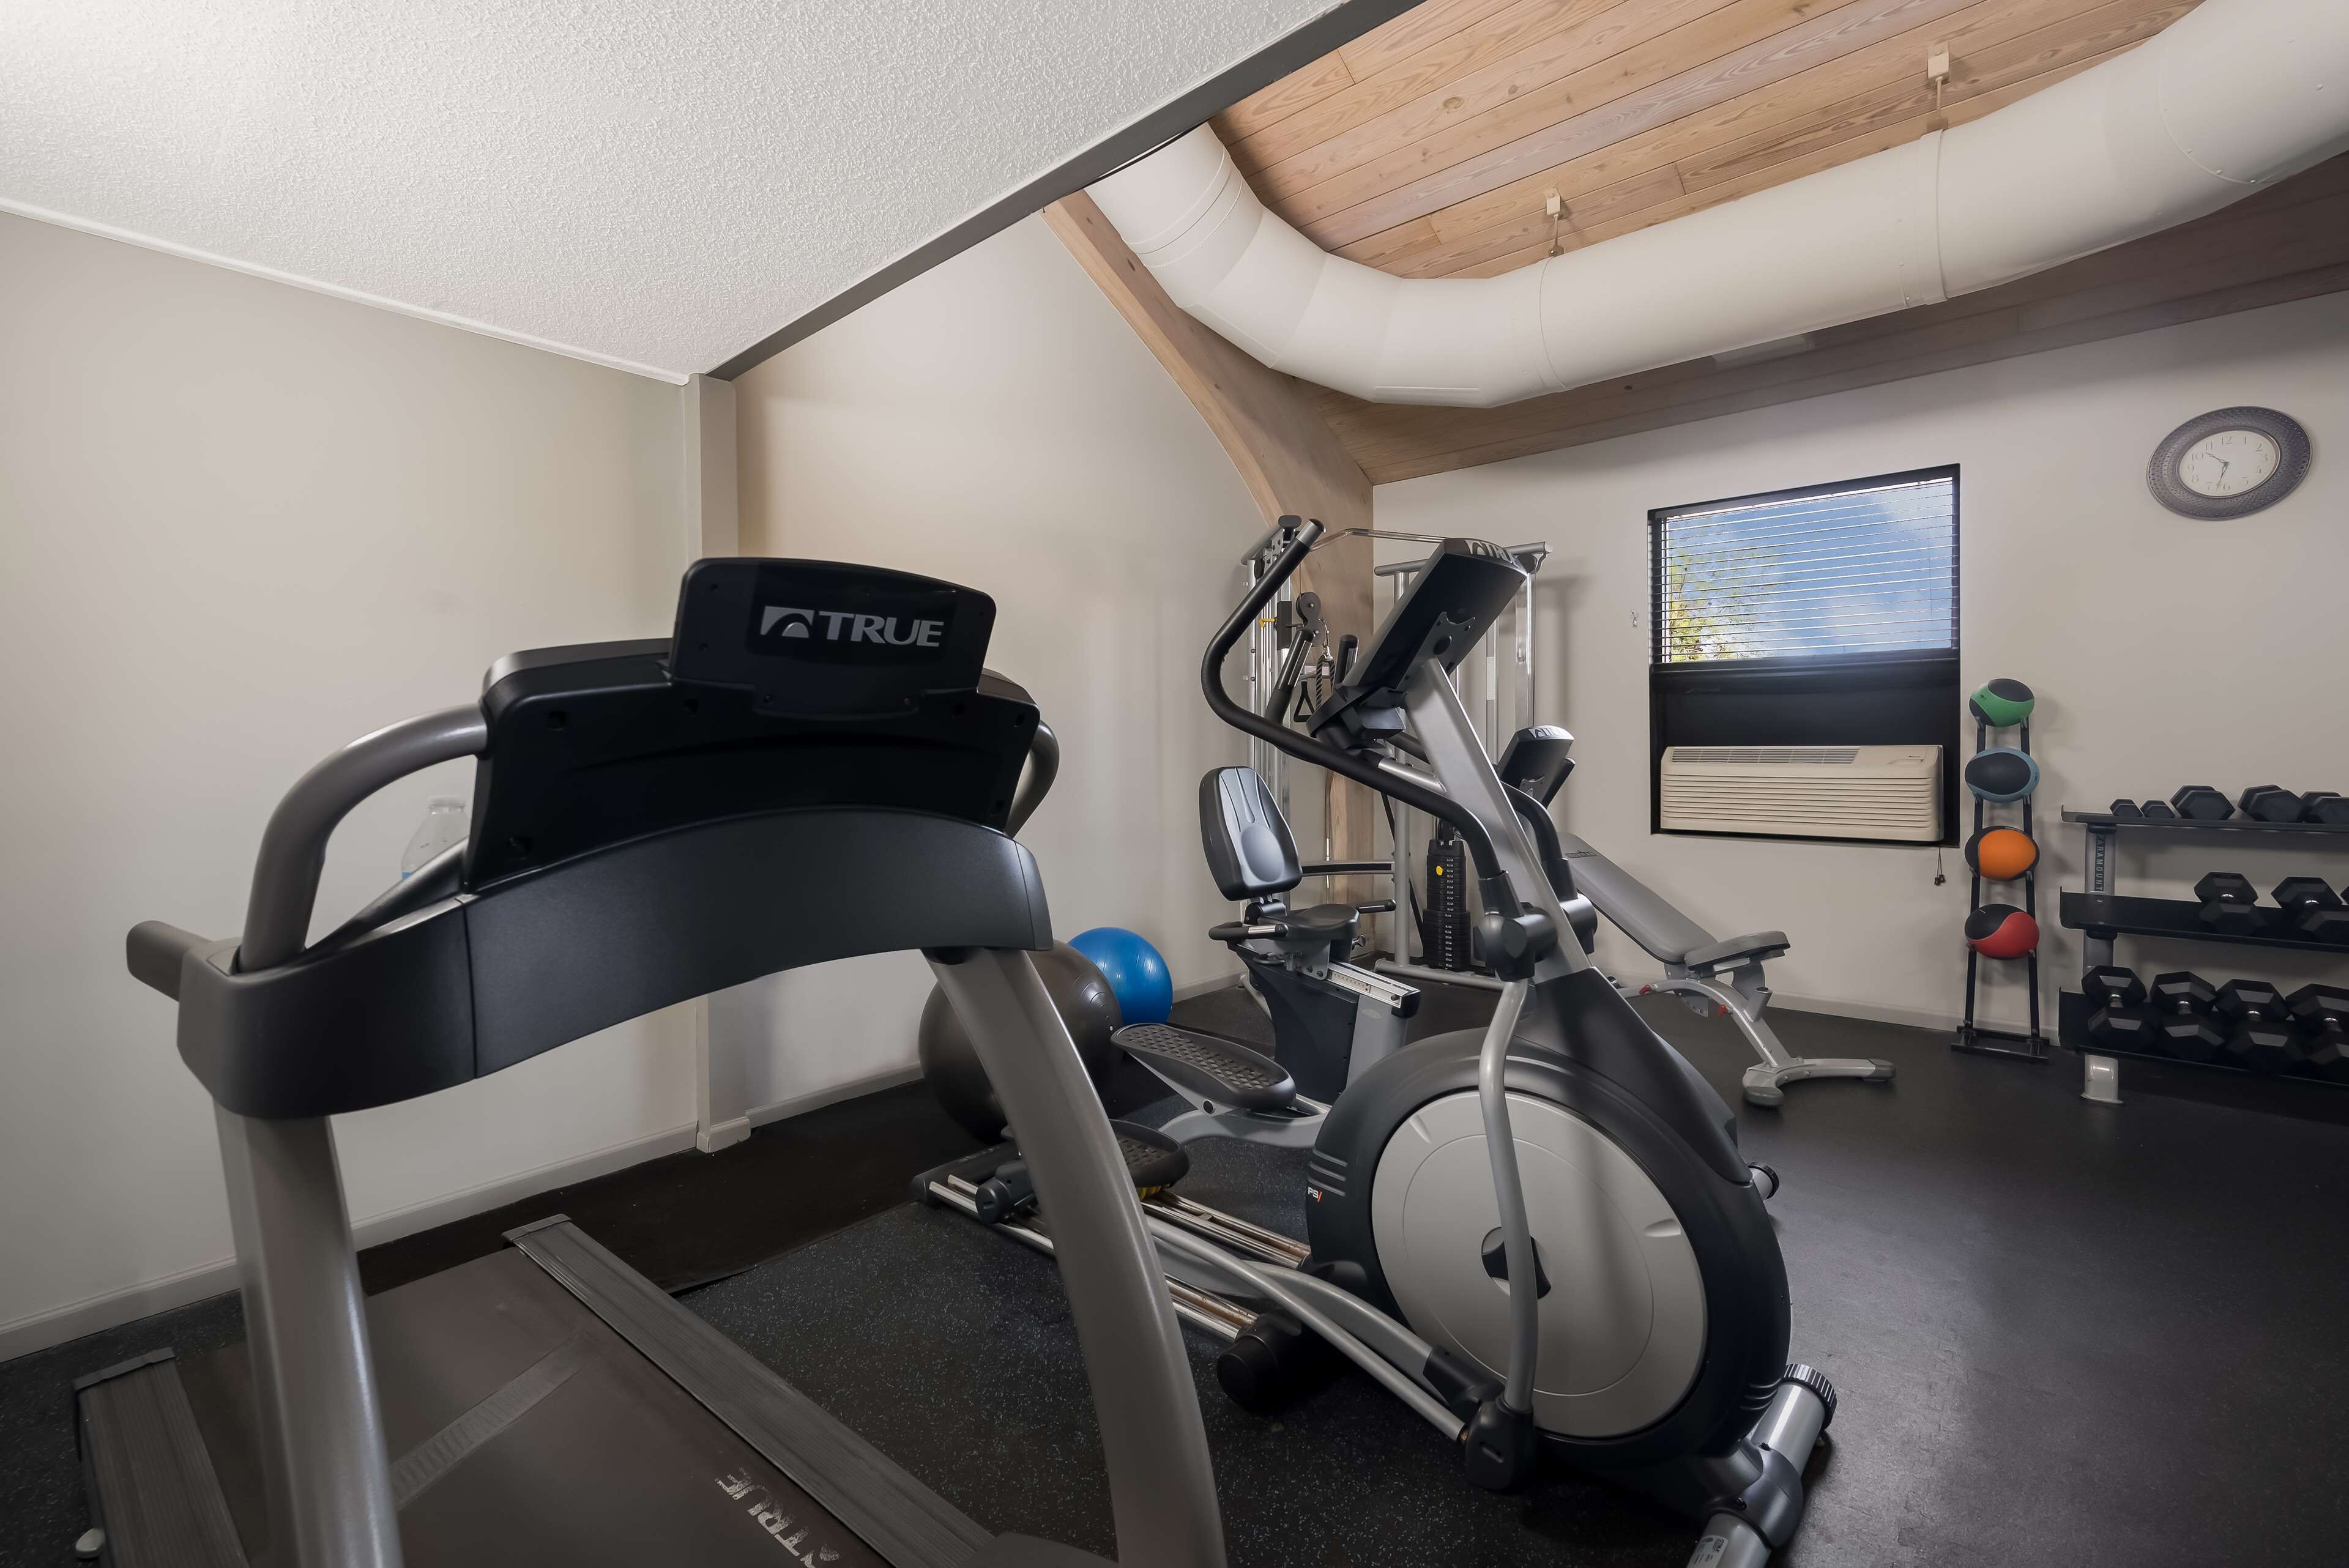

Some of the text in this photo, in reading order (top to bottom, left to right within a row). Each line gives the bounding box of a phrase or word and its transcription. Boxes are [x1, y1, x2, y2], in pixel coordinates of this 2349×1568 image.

[2220, 436, 2232, 445] 12
[2204, 440, 2213, 451] 11
[2254, 443, 2262, 452] 2
[2191, 452, 2203, 461] 10
[2262, 453, 2268, 462] 3
[2255, 465, 2262, 474] 4
[2191, 474, 2199, 483] 8
[2241, 476, 2249, 486] 5
[2205, 481, 2213, 491] 7
[2222, 482, 2231, 491] 6
[819, 611, 944, 647] TRUE
[2096, 833, 2104, 891] PARAMOUNT
[715, 1466, 810, 1556] TRUE
